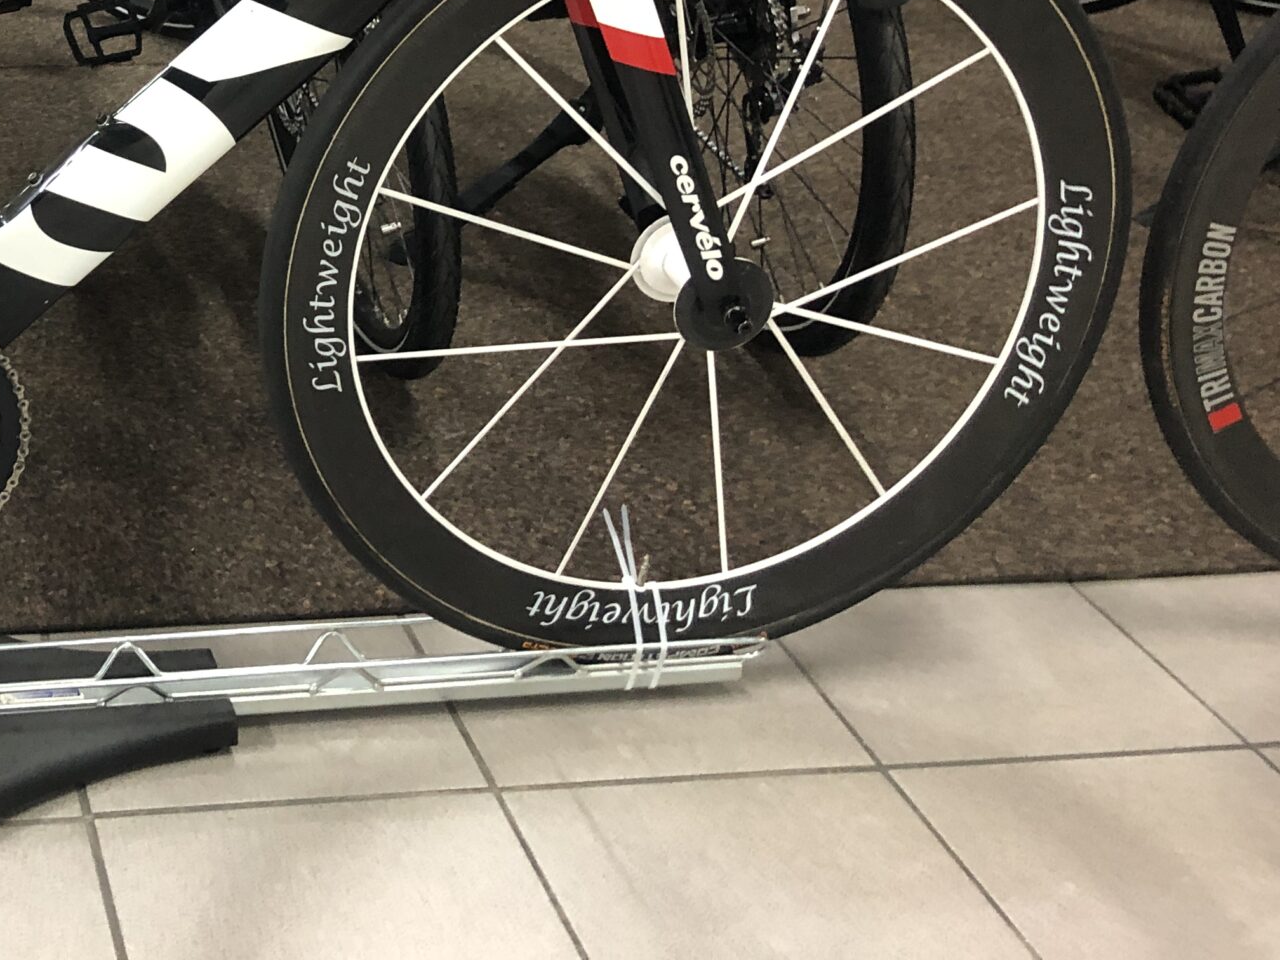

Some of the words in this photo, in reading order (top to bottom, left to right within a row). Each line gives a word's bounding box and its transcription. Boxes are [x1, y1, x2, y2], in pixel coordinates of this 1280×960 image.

[302, 157, 370, 394] Lightweight
[1004, 179, 1094, 408] Lightweight
[525, 583, 758, 633] Lightweight
